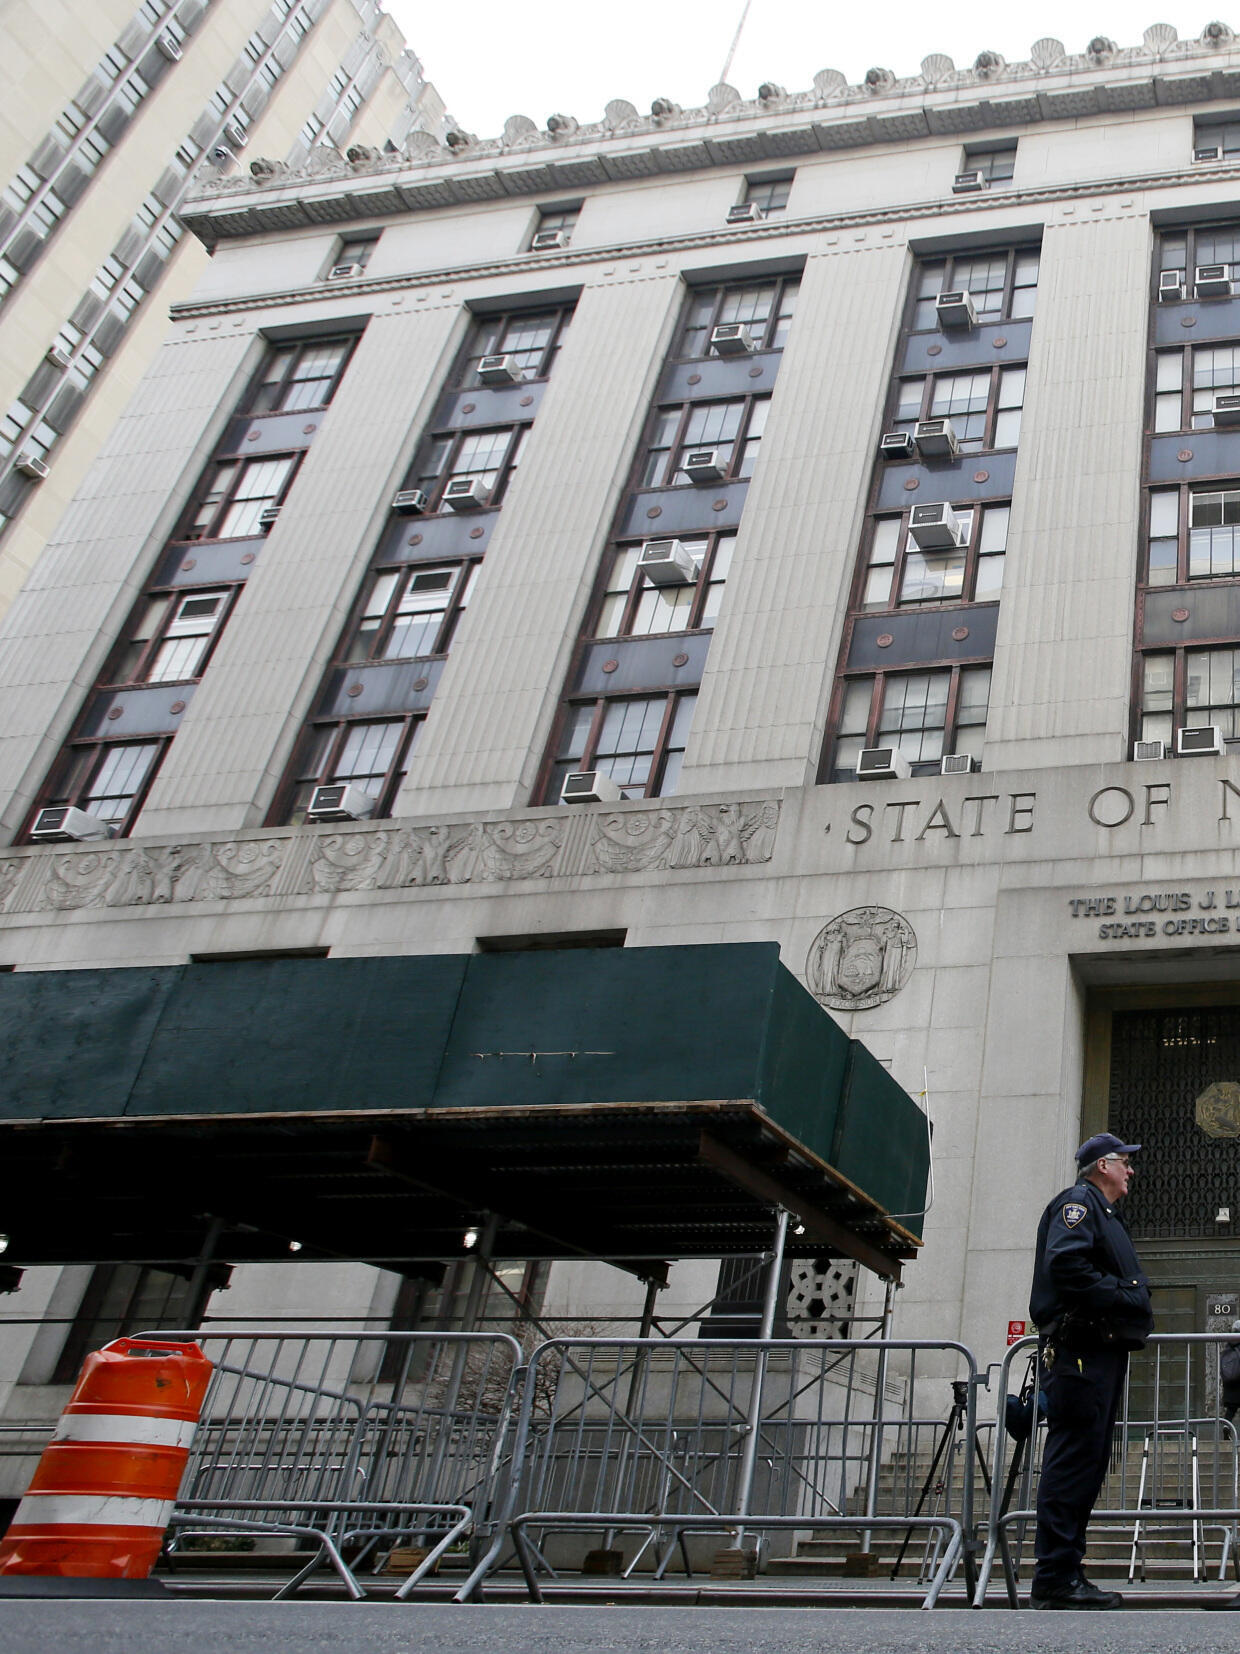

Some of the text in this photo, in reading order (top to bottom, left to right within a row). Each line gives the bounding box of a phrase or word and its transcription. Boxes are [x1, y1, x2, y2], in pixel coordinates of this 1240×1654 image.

[846, 792, 1037, 845] STATE
[1088, 783, 1172, 828] OF
[1068, 896, 1117, 918] THE
[1123, 892, 1192, 915] LOUIS
[1198, 890, 1218, 910] J.
[1099, 921, 1157, 939] STATE
[1162, 916, 1230, 936] OFFICE
[1214, 1304, 1231, 1315] 80
